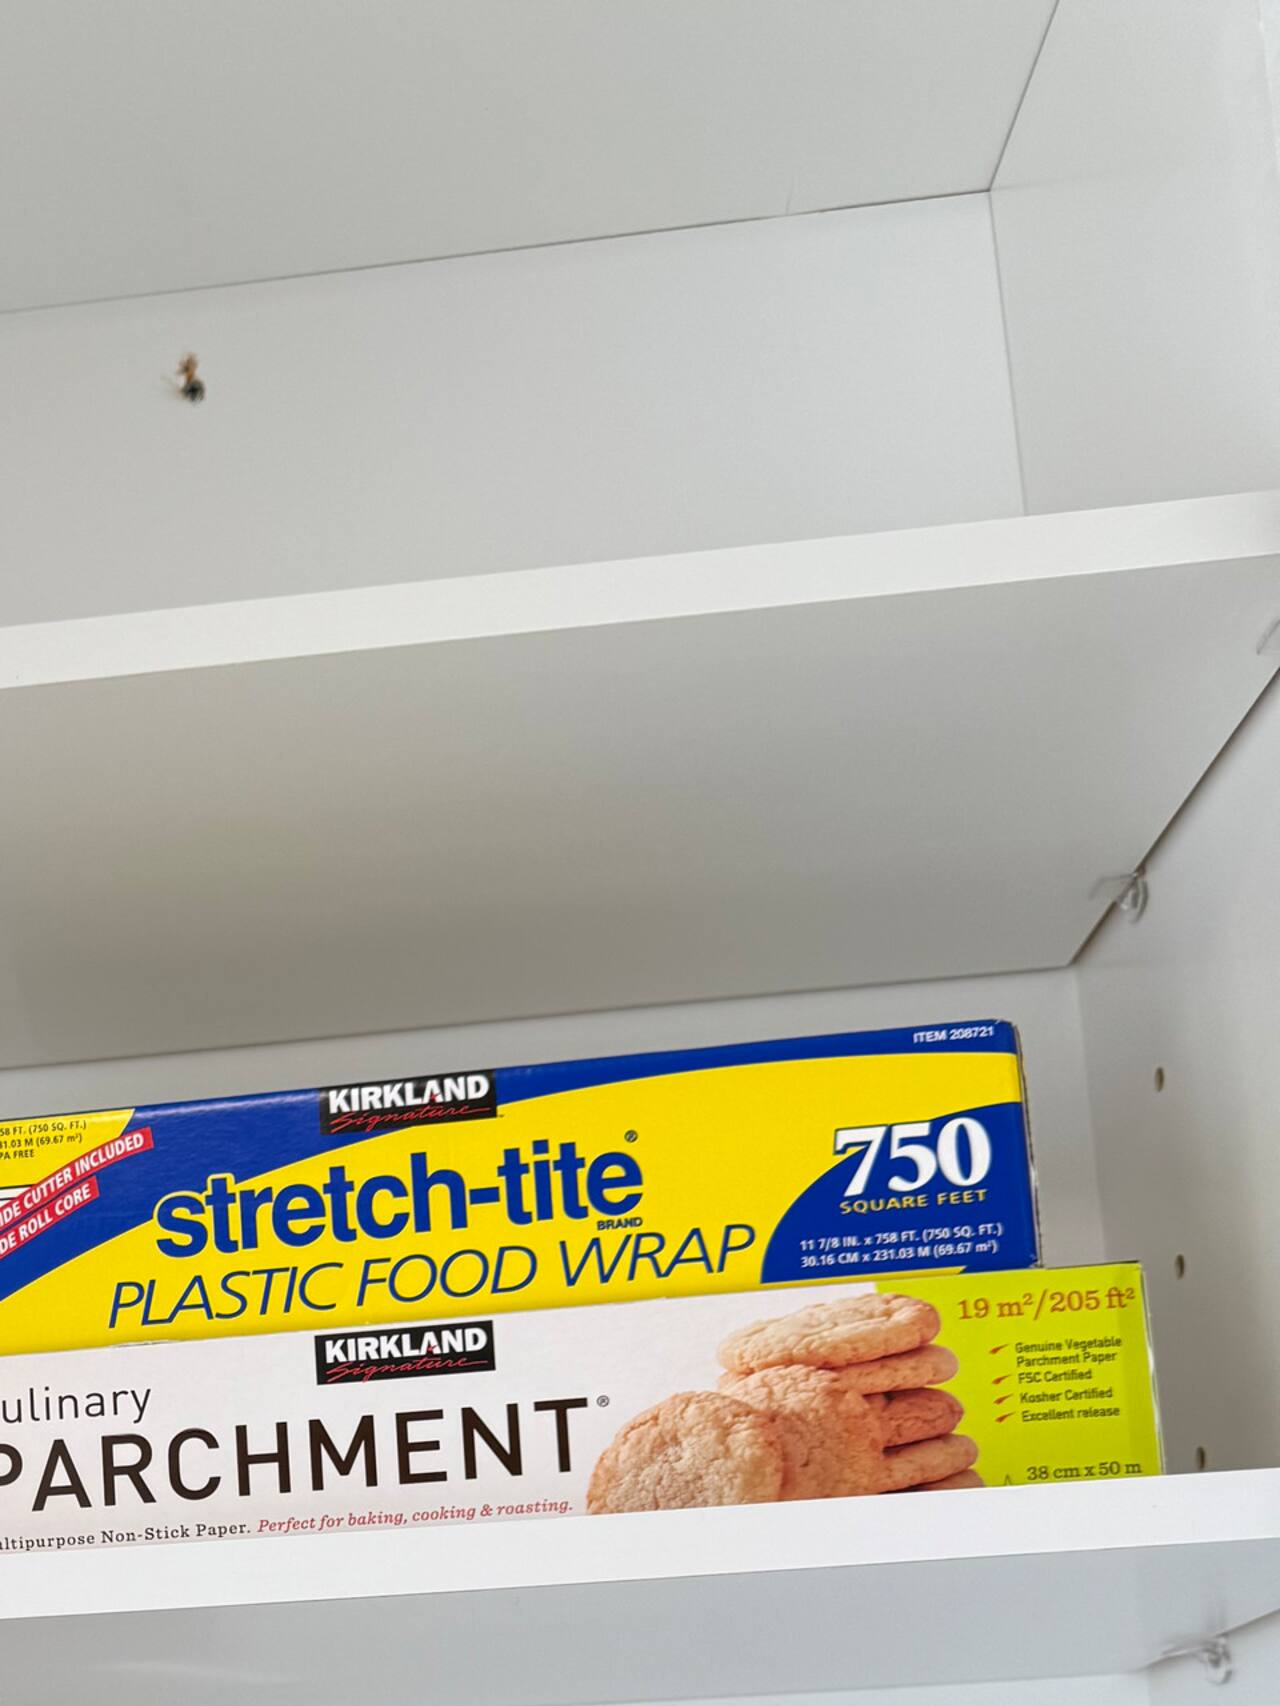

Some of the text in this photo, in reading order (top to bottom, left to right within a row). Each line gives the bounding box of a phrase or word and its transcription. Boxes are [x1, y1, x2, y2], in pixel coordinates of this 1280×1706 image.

[913, 1026, 995, 1043] ITEM 208721
[328, 1074, 491, 1115] KIRKLAND
[12, 1125, 27, 1135] FT.
[51, 1121, 68, 1133] SQ.
[70, 1120, 87, 1131] FT.)
[329, 1102, 491, 1134] Signature
[24, 1138, 34, 1147] M
[36, 1134, 64, 1147] (69.67
[13, 1149, 35, 1159] FREE
[834, 1116, 992, 1197] 750
[23, 1169, 73, 1210] CUTTER
[74, 1132, 144, 1177] INCLUDED
[19, 1211, 53, 1240] ROLL
[54, 1183, 91, 1216] CORE
[839, 1189, 988, 1214] SQUARE FEET
[597, 1217, 643, 1231] BRAND
[800, 1239, 816, 1250] 11
[818, 1237, 840, 1250] 7/8
[842, 1235, 861, 1246] IN.
[876, 1232, 897, 1244] 758
[901, 1230, 919, 1242] FT.
[922, 1227, 950, 1243] (750
[952, 1226, 975, 1239] SQ.
[978, 1223, 1004, 1236] FT.)
[801, 1255, 835, 1267] 30.16
[838, 1252, 858, 1265] CM
[873, 1247, 915, 1261] 231.03
[917, 1245, 930, 1257] M
[933, 1242, 971, 1259] (69.67
[109, 1224, 755, 1329] PLASTIC FOOD WRAP
[958, 1298, 989, 1320] 19
[324, 1327, 488, 1364] KIRKLAND
[1015, 1337, 1122, 1353] Genuine Vegetable
[325, 1355, 489, 1383] Signature
[1017, 1352, 1118, 1367] Parchment Paper
[1018, 1369, 1092, 1384] FSC Certified
[1020, 1387, 1113, 1404] Kosher Certified
[1022, 1406, 1120, 1422] Excellent release
[1026, 1461, 1142, 1480] 38 cm x 50 m
[101, 1523, 190, 1544] Non-Stick
[195, 1522, 251, 1540] Paper.
[257, 1515, 316, 1533] Perfect
[317, 1512, 344, 1532] for
[348, 1509, 408, 1529] baking,
[412, 1505, 475, 1525] cooking
[480, 1503, 493, 1518] &
[497, 1498, 573, 1520] roasting.
